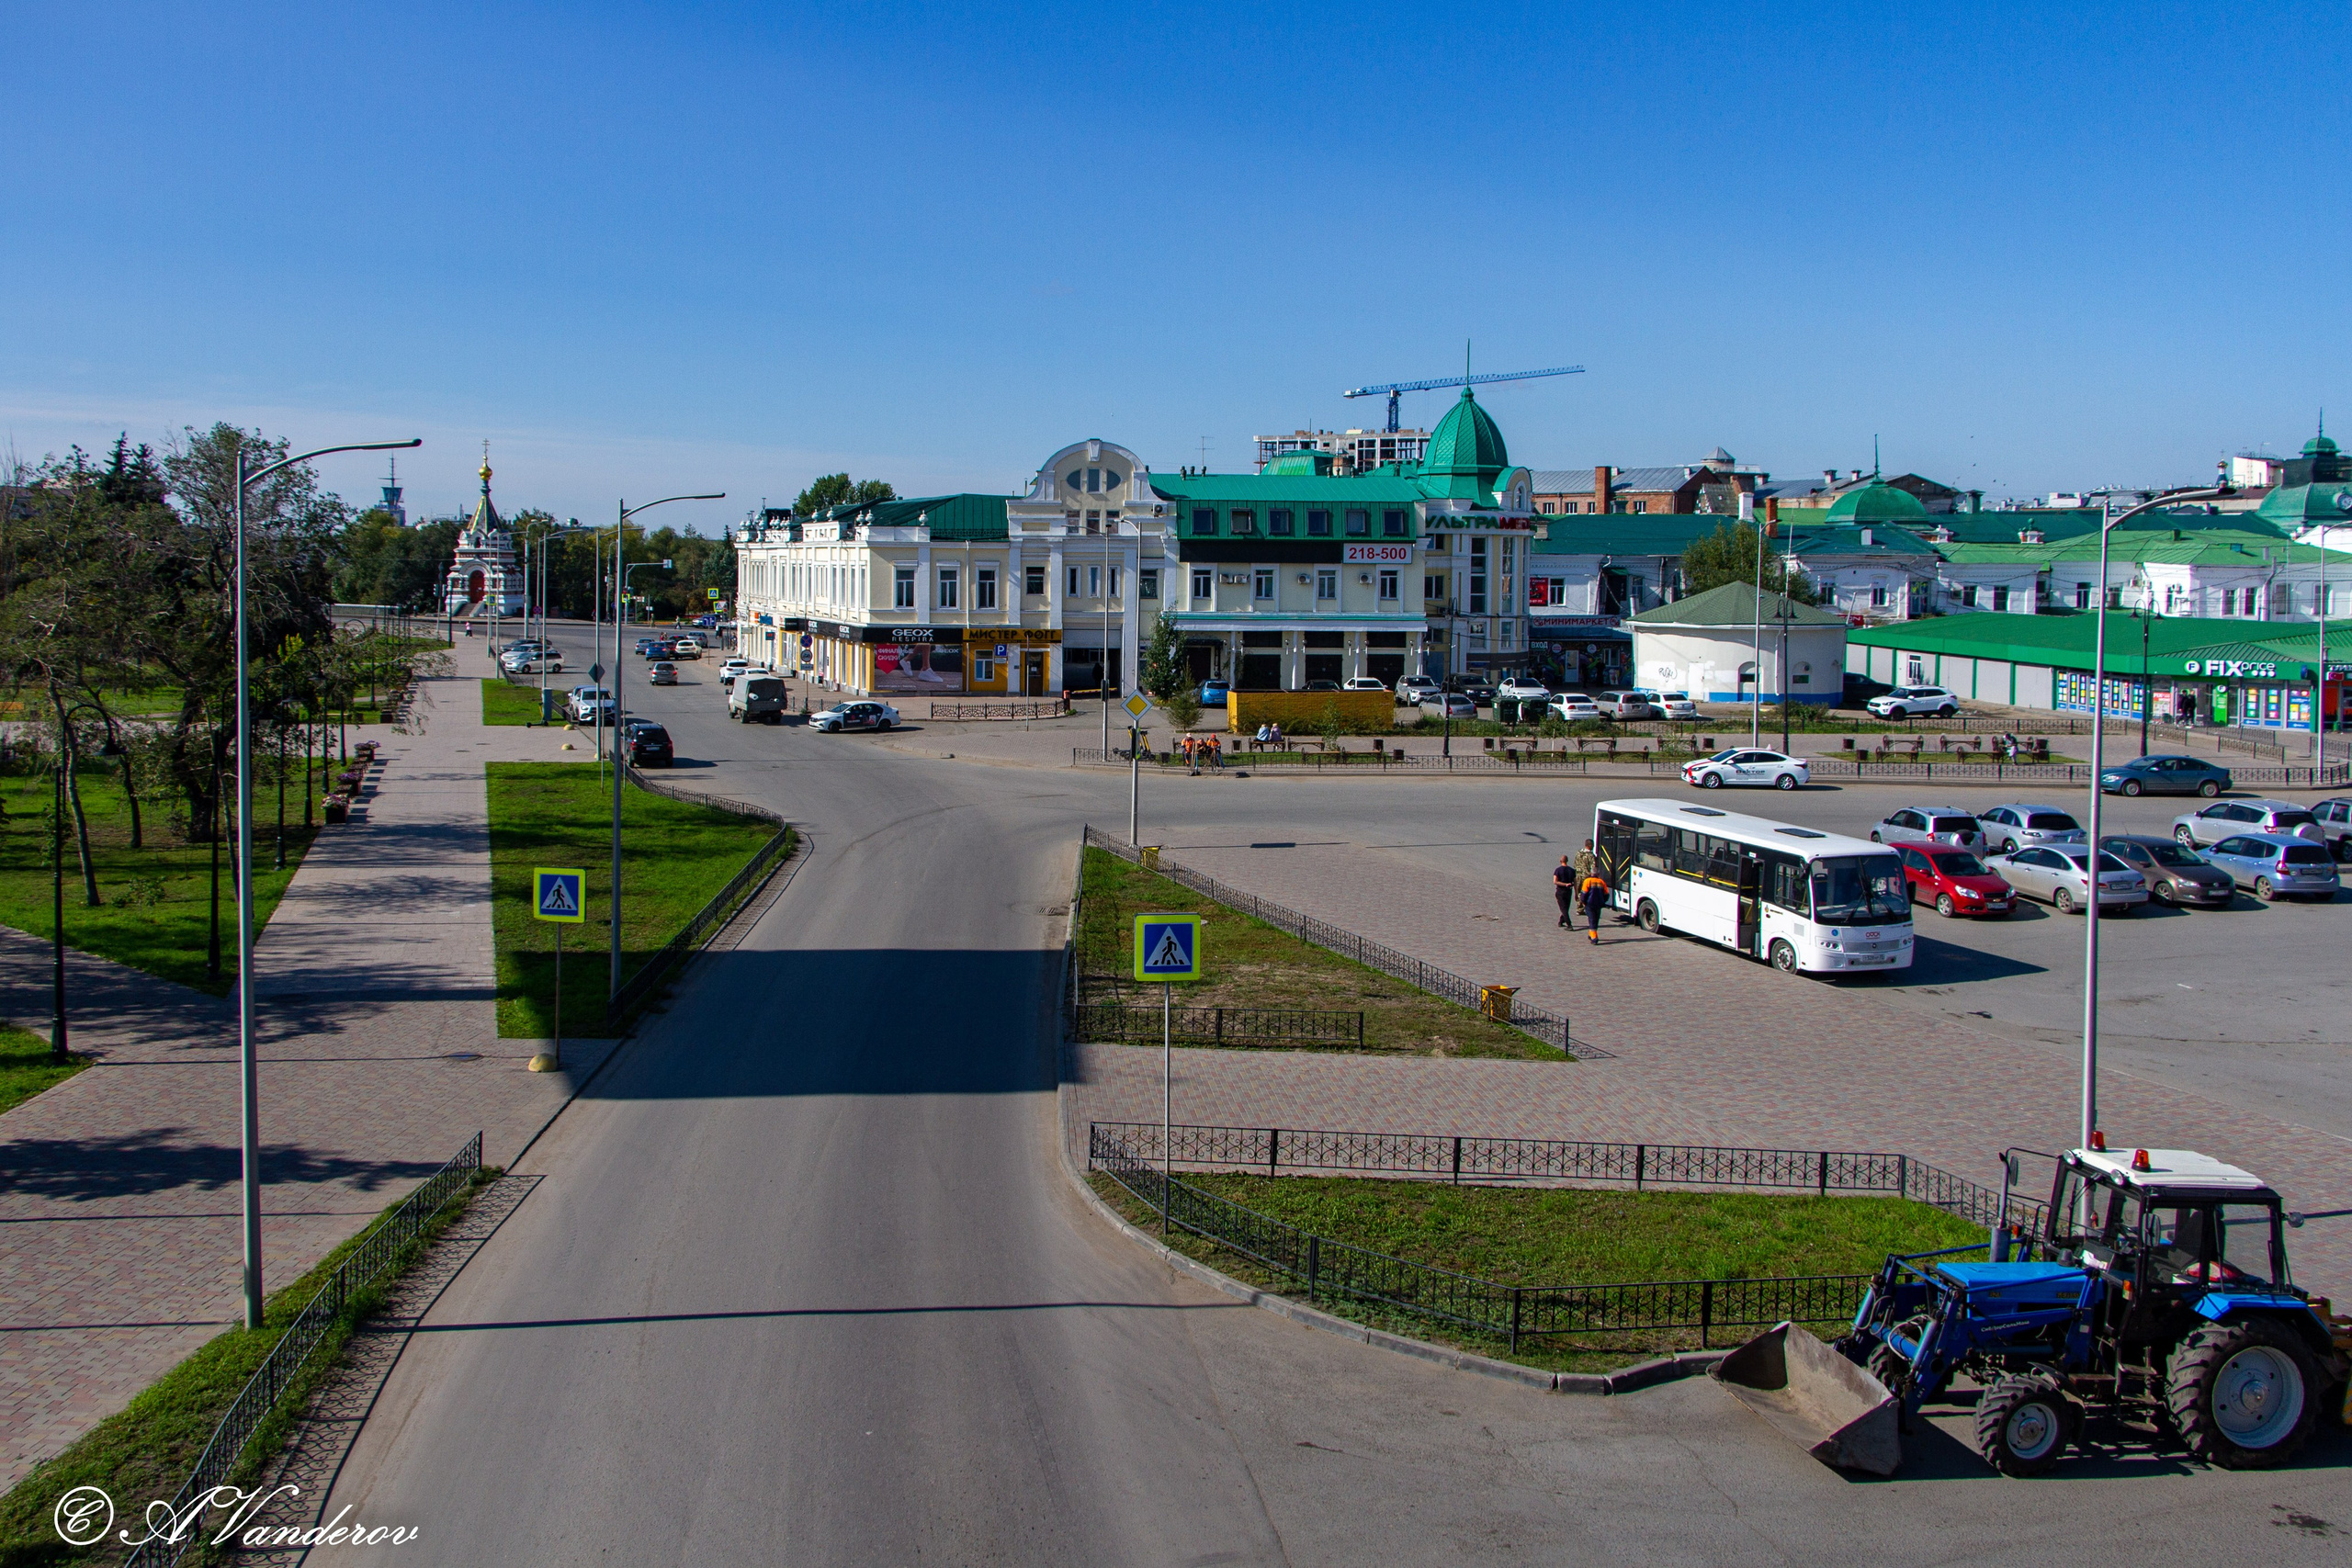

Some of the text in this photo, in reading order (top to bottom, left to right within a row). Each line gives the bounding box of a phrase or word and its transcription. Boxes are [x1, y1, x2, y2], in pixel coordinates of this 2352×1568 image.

[1348, 546, 1407, 561] 218-500
[1544, 617, 1609, 626] МИНИМАРКЕТ
[969, 629, 1057, 639] МИСТЕР ФОГГ
[1531, 641, 1549, 649] ВХОД
